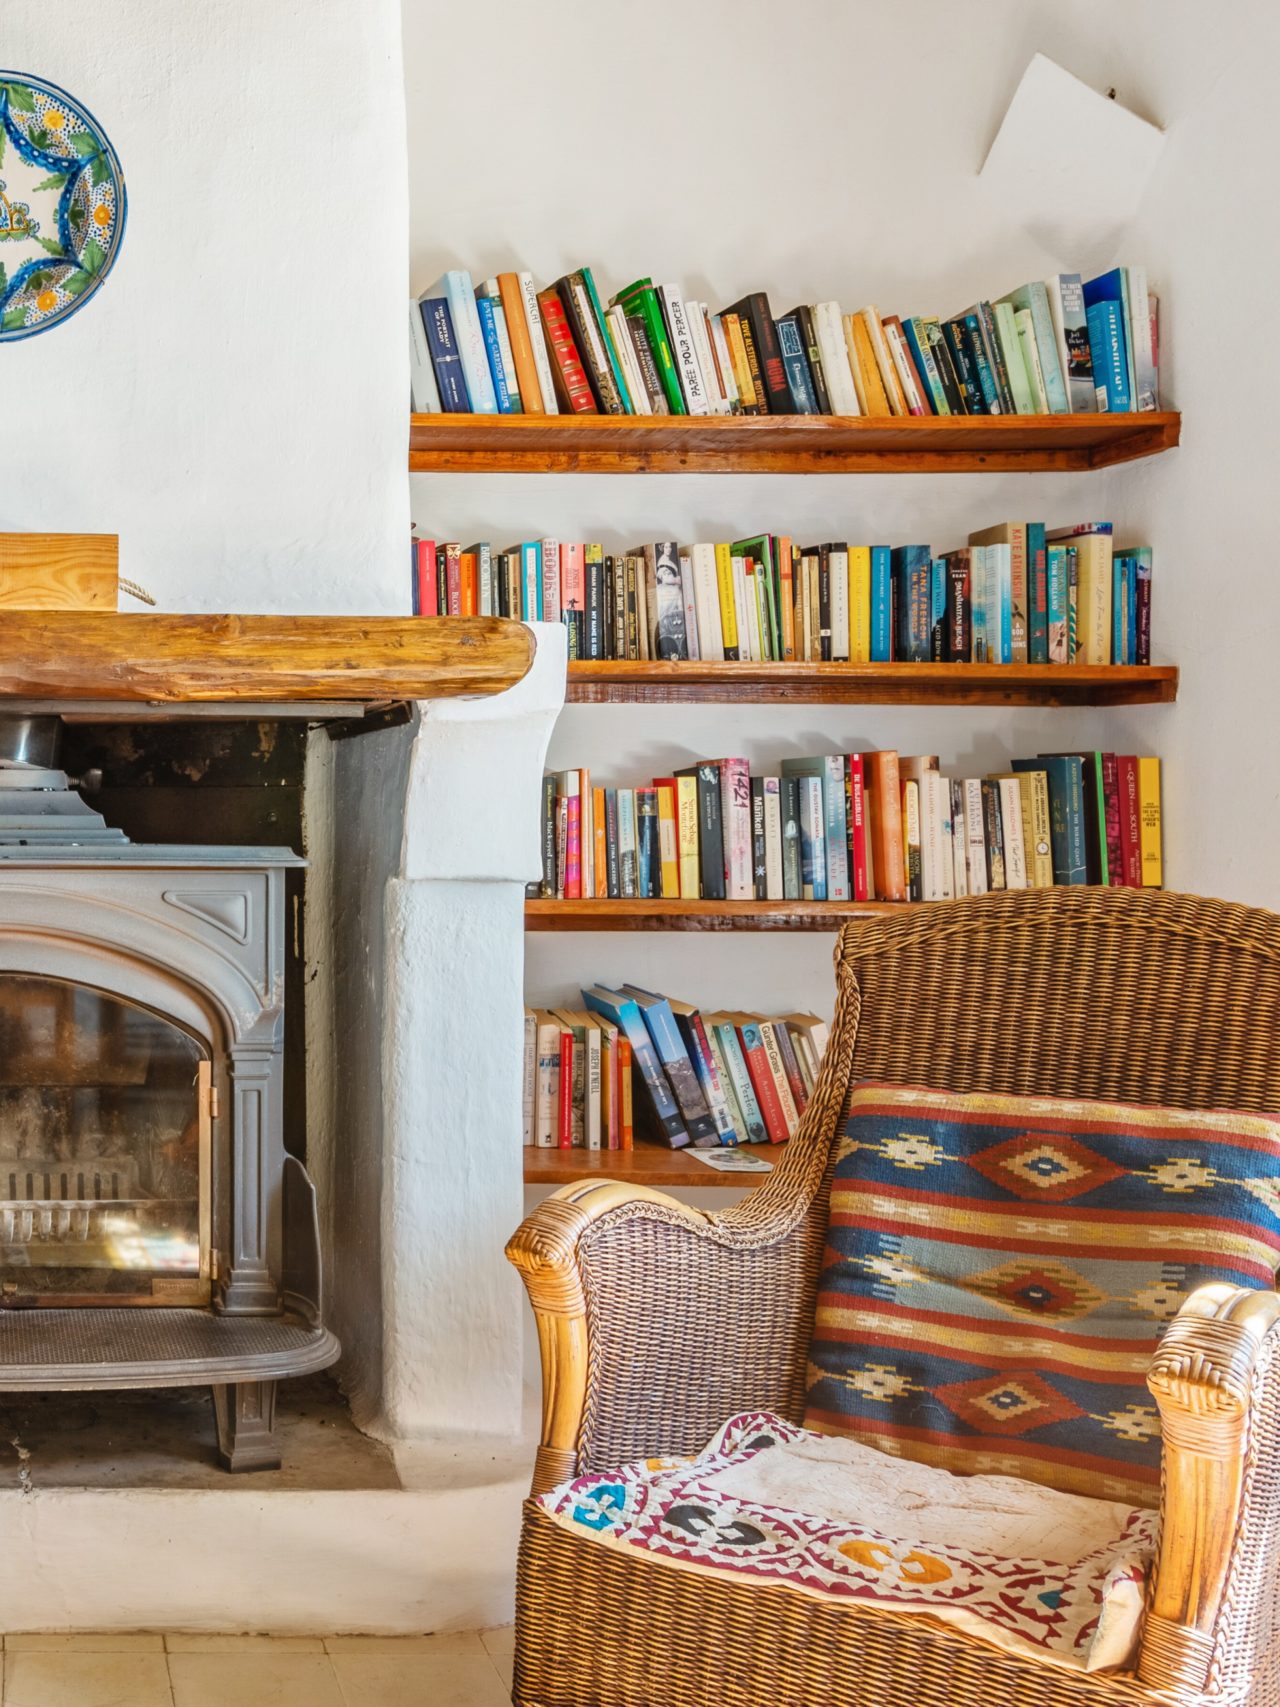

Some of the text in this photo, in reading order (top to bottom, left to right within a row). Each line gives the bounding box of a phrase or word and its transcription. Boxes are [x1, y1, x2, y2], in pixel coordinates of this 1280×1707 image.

[525, 280, 540, 325] SUPERCAT
[671, 302, 685, 336] PERCER
[437, 327, 445, 343] LADY
[439, 319, 451, 348] PORTRAIT
[487, 319, 494, 329] ME
[638, 329, 647, 350] SUITE
[493, 344, 505, 379] GARRISON
[680, 339, 693, 365] POUR
[741, 319, 760, 377] TOVE ALSTERDAL
[913, 320, 936, 373] CATHERINE COOKSON
[766, 357, 787, 393] MONA
[481, 546, 491, 598] BROOKLYN
[544, 547, 557, 593] BOOK
[912, 573, 918, 581] IN
[1012, 529, 1023, 599] KATE ATKINSON
[1036, 550, 1045, 612] KATE ATKINSON
[616, 578, 624, 595] GREAT
[954, 581, 964, 650] MANHATTAN BEACH
[569, 622, 577, 646] CLOSING
[731, 771, 749, 809] 1421
[854, 774, 861, 783] DE
[1126, 772, 1136, 799] QUEEN
[681, 801, 689, 843] Montefiore
[687, 799, 696, 845] Simon Sebag
[754, 797, 763, 835] Mankell
[968, 783, 976, 832] RATHBONE
[1009, 807, 1017, 836] FELLOWES
[1129, 815, 1138, 843] SOUTH
[576, 1050, 584, 1077] PATRICK
[590, 1048, 600, 1095] JOSEPH O'NEILL
[761, 1025, 796, 1123] Günter Grass The Flounder
[740, 1083, 756, 1117] Perfect
[762, 1080, 779, 1127] Andrea Levy
